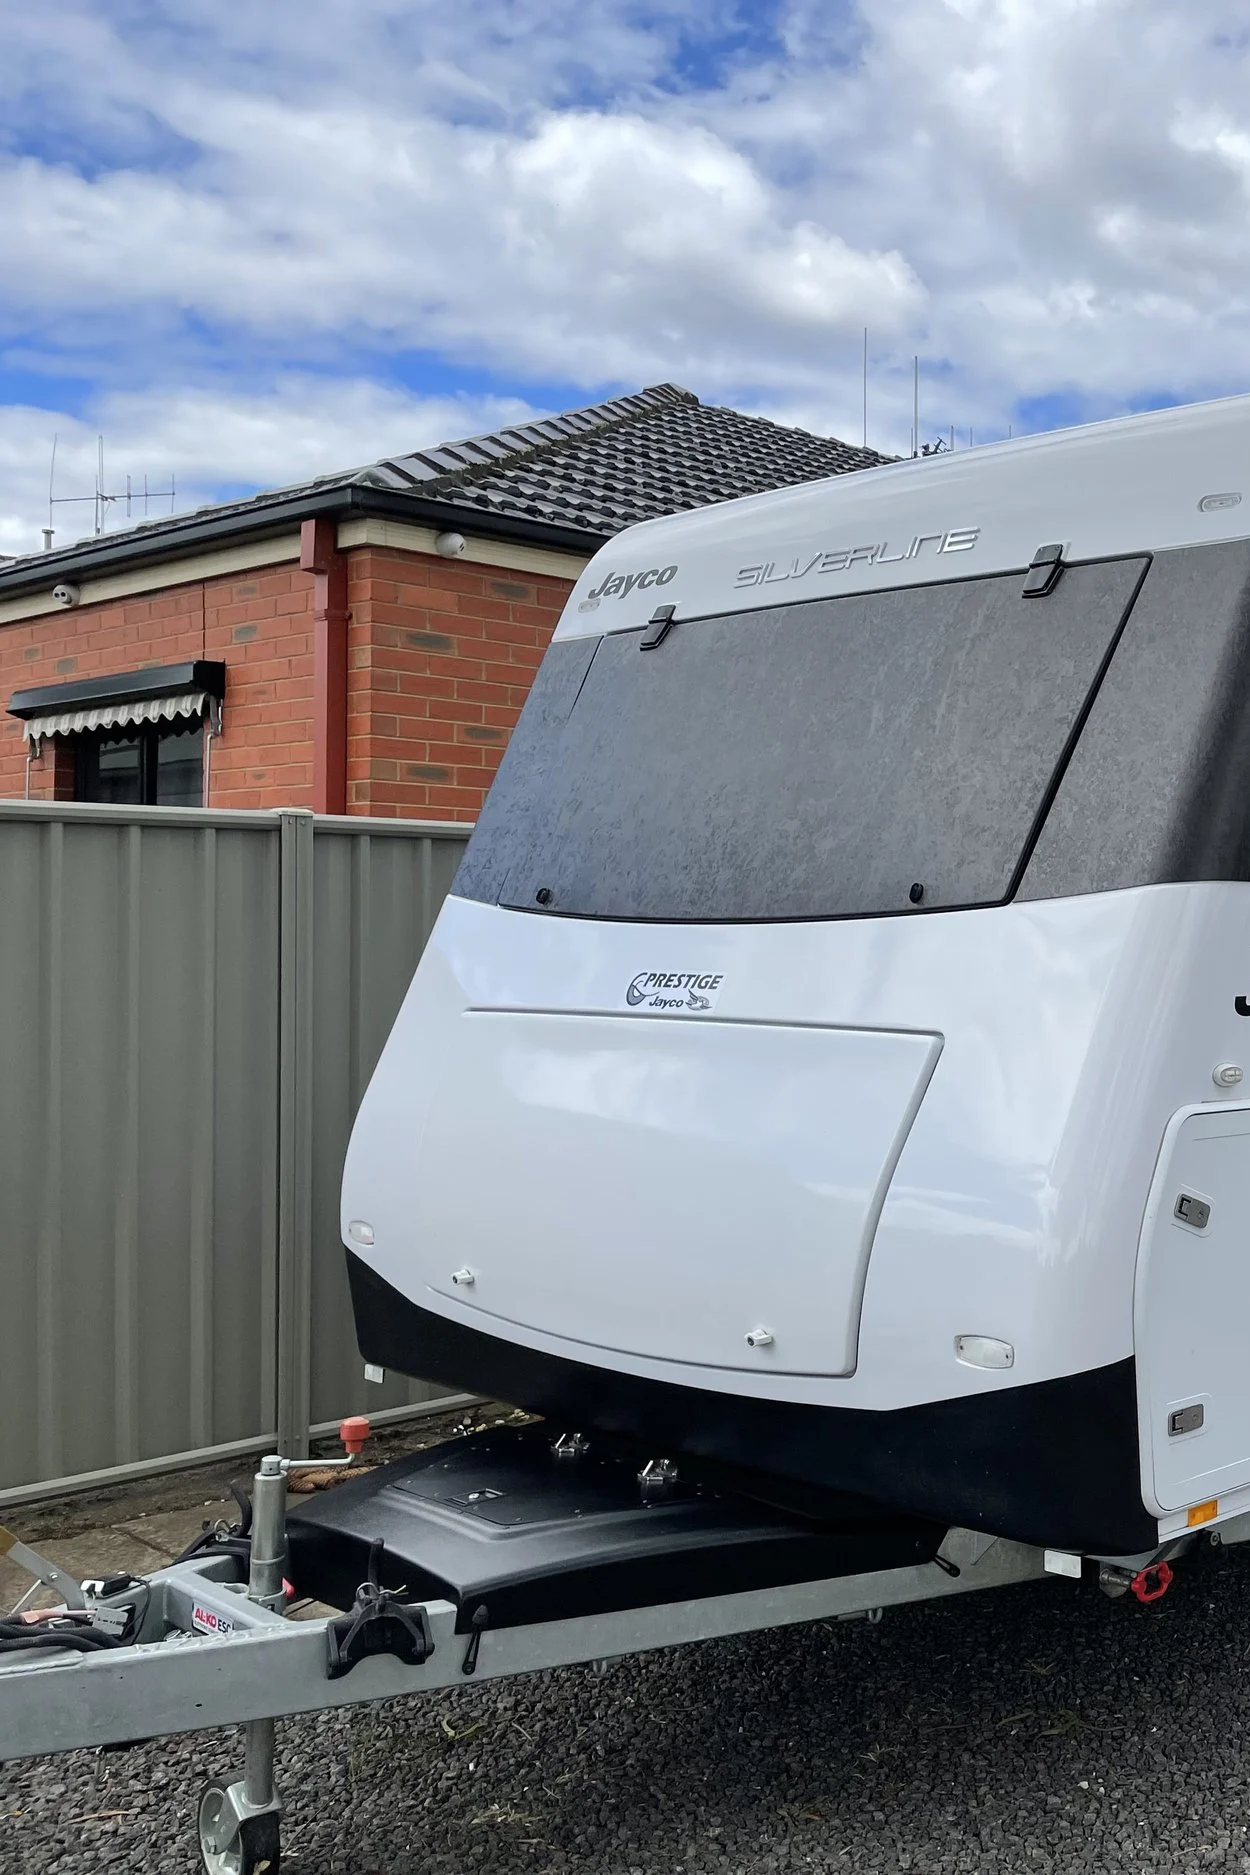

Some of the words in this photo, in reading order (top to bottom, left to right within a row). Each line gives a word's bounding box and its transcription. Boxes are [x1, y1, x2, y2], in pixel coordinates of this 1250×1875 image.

[733, 526, 981, 589] SILVERLINE
[588, 565, 678, 600] Jayco
[643, 972, 724, 990] PRESTIGE
[648, 995, 684, 1009] Jayco
